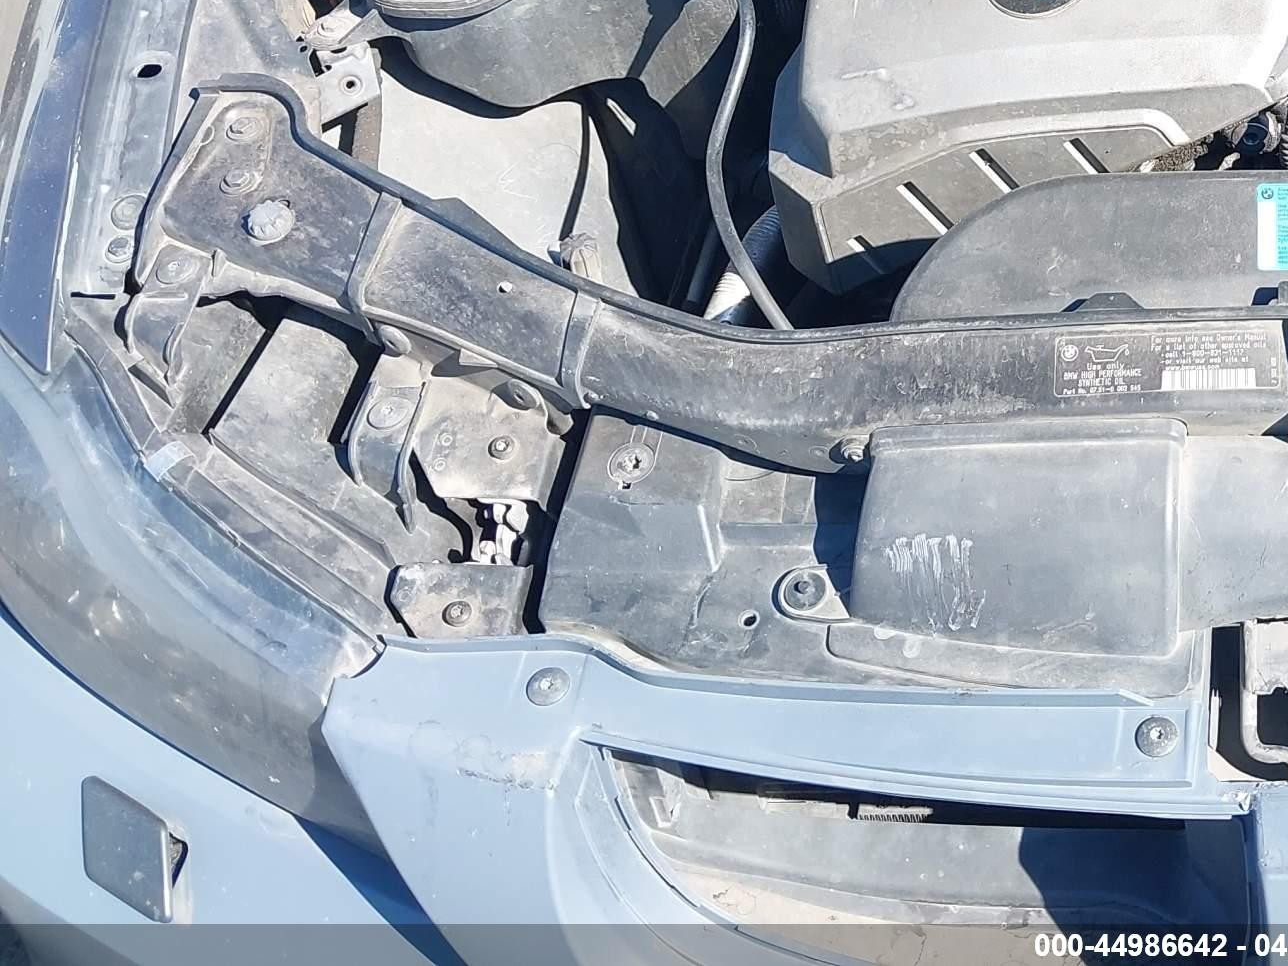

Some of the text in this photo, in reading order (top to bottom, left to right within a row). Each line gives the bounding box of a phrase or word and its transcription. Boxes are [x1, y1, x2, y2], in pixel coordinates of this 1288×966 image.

[1151, 335, 1162, 344] For
[1244, 332, 1266, 340] Manual
[1151, 344, 1162, 352] For
[1189, 342, 1198, 350] of
[1200, 341, 1217, 350] other
[1086, 361, 1125, 371] Use only
[1063, 368, 1142, 380] BMW HIGH PERFORMANCE
[1077, 377, 1126, 387] SYNTHETIC OIL
